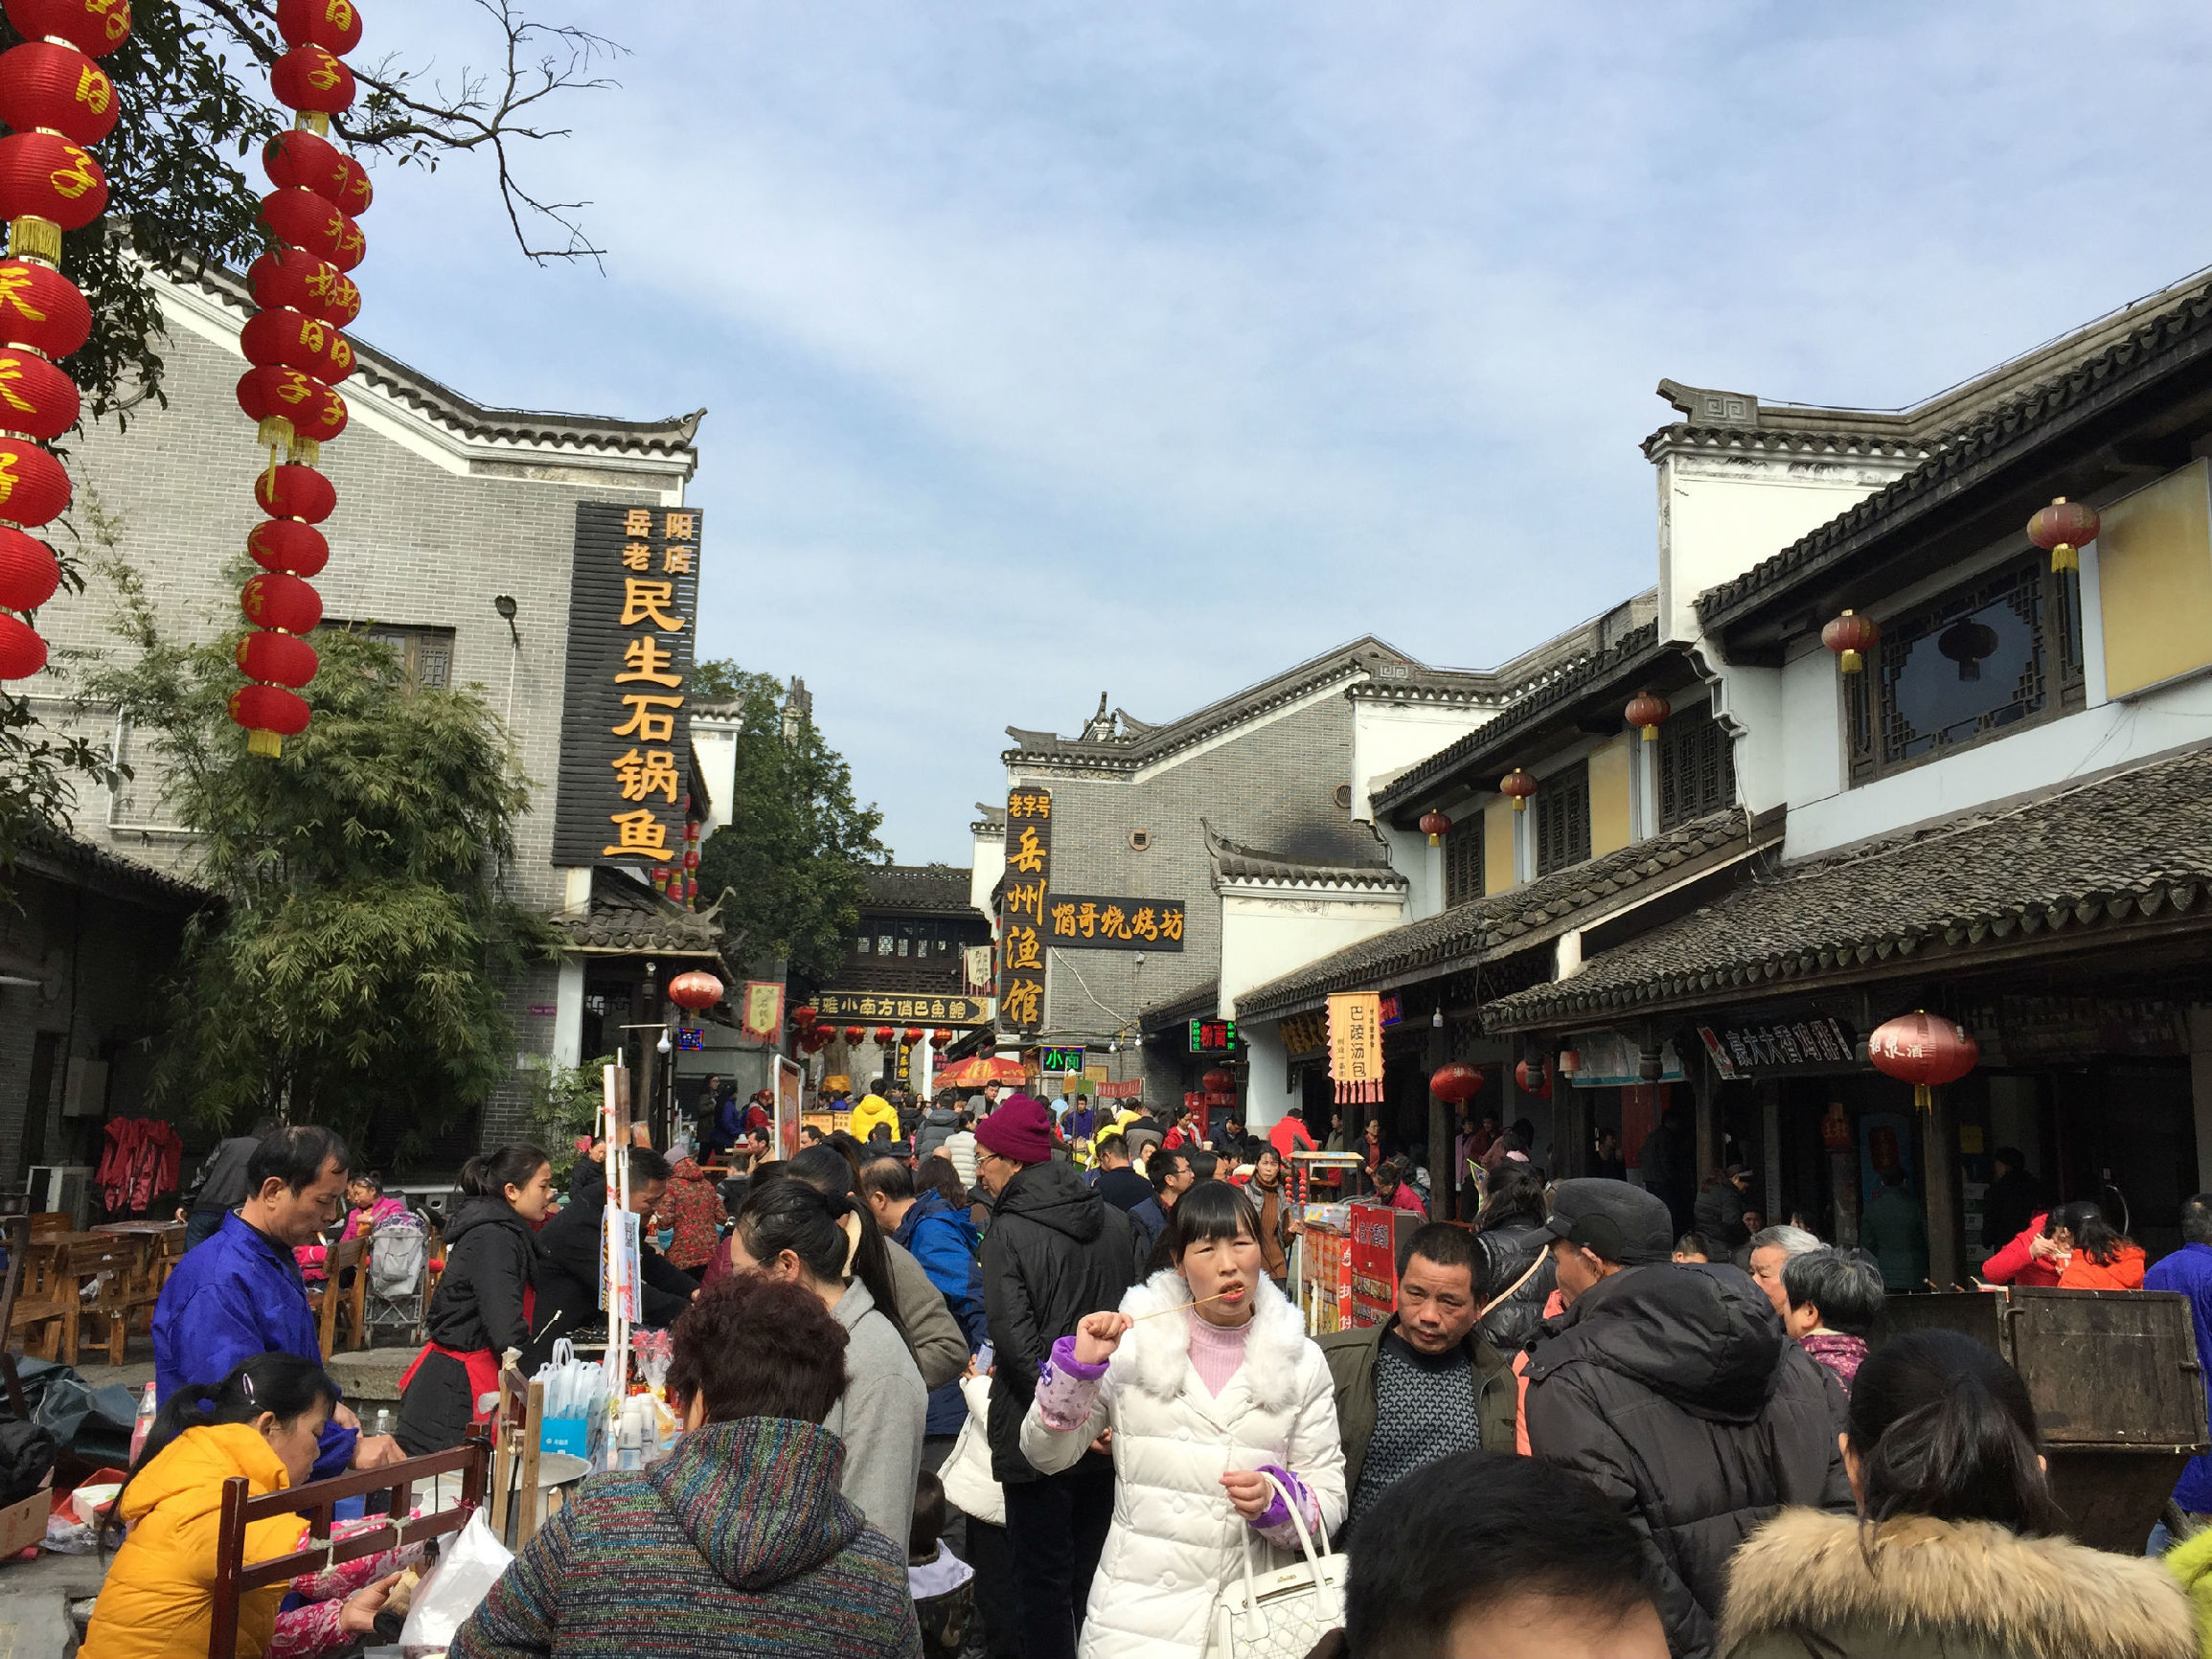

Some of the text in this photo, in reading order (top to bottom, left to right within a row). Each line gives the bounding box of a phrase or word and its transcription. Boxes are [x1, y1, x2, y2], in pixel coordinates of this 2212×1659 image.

[623, 509, 693, 540] 岳阳
[622, 542, 692, 574] 老店
[603, 578, 686, 861] 民生石锅鱼
[1009, 794, 1051, 819] 老字号
[1002, 826, 1047, 1025] 岳州渔馆
[1350, 1006, 1366, 1078] 巴陵汤包
